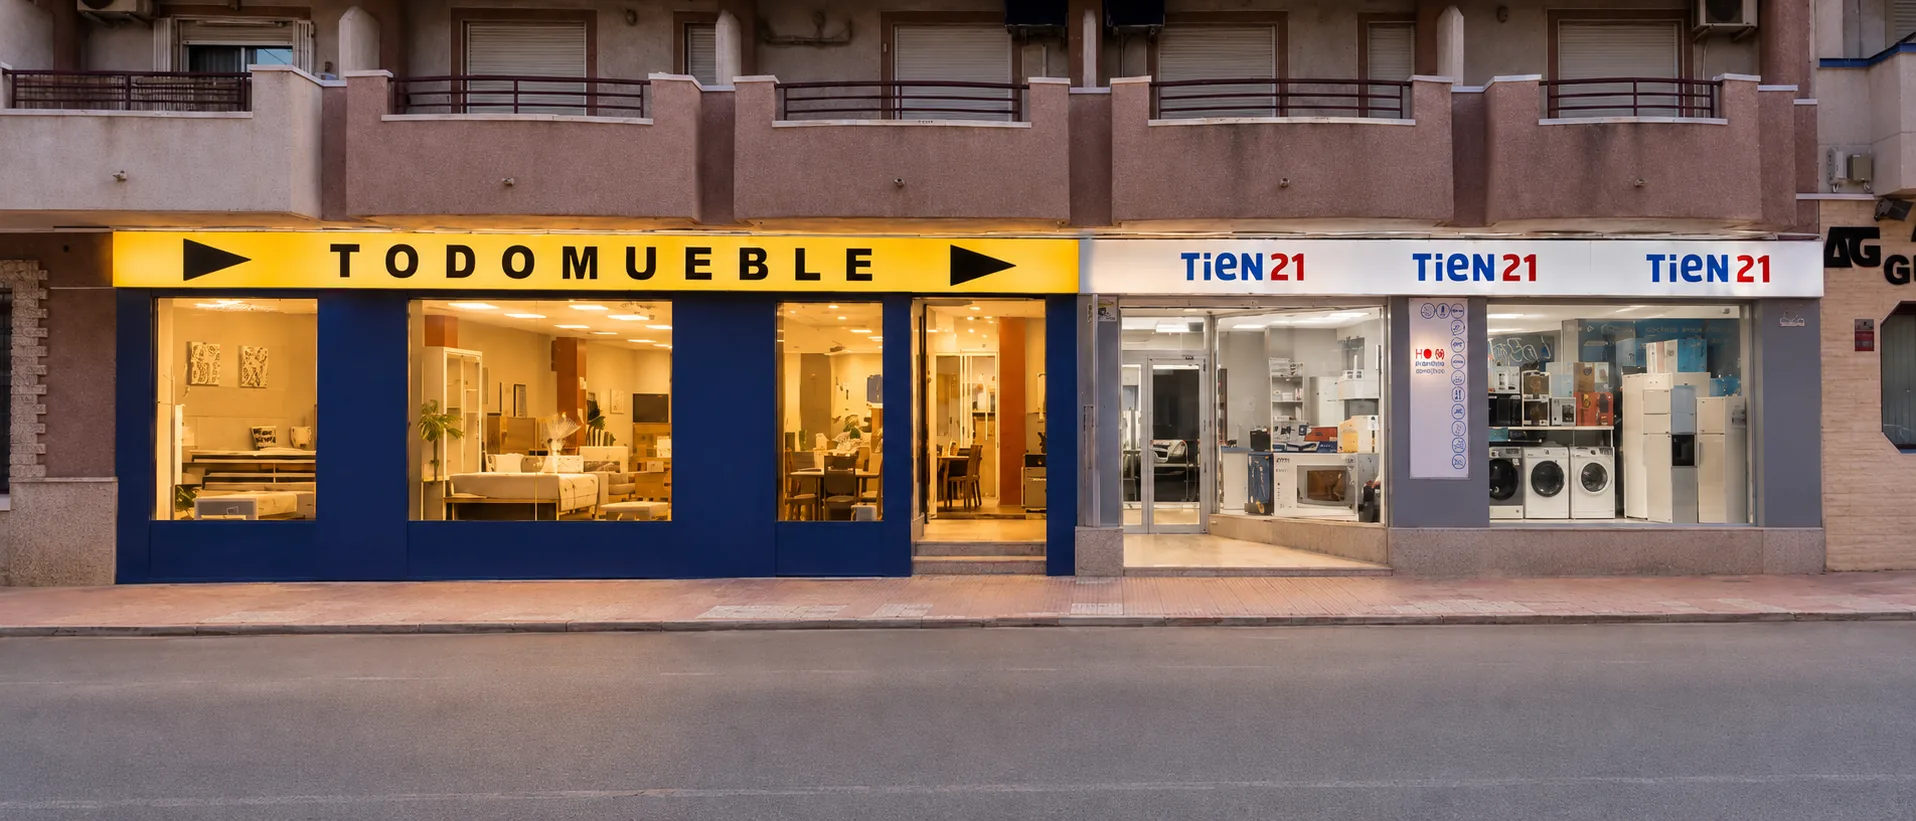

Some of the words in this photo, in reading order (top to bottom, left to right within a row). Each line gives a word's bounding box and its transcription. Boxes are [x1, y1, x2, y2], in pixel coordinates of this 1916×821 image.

[330, 243, 873, 281] TODOMUEBLE
[1824, 227, 1881, 268] AG
[1270, 253, 1304, 281] 21
[1502, 253, 1537, 282] 21
[1736, 255, 1770, 283] 21
